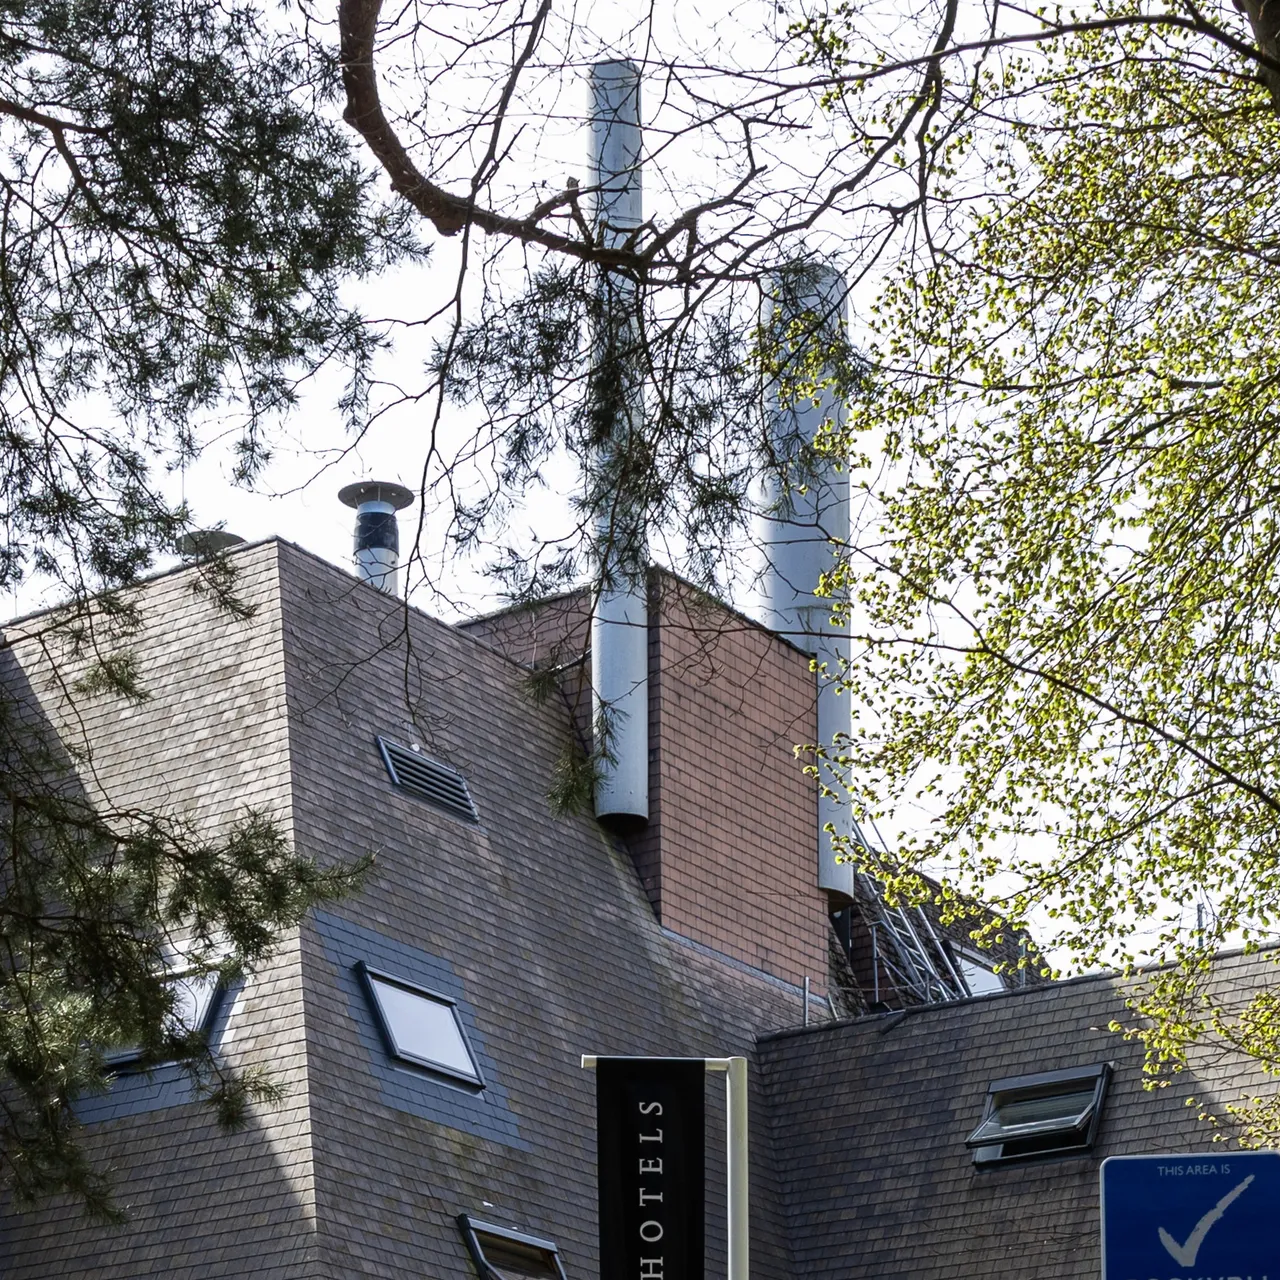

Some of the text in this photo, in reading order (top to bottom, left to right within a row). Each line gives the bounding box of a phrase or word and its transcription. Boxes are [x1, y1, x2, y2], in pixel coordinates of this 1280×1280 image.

[639, 1102, 664, 1280] HOTELS
[1157, 1163, 1231, 1176] THIS AREA IS
